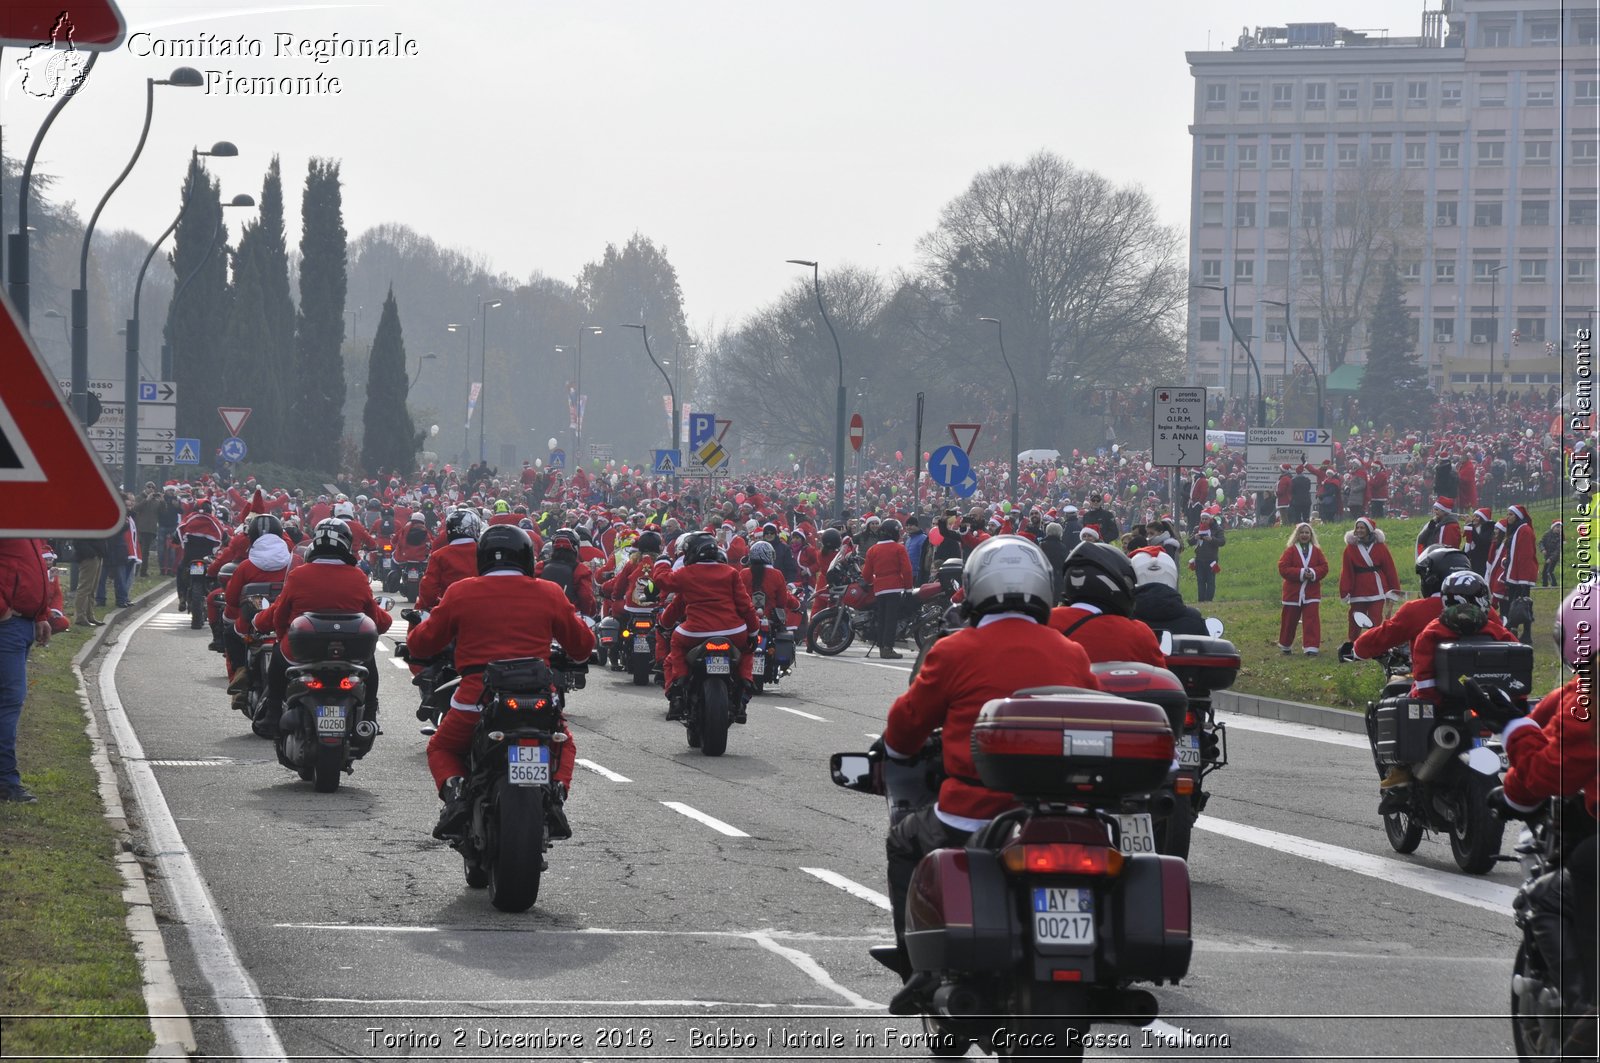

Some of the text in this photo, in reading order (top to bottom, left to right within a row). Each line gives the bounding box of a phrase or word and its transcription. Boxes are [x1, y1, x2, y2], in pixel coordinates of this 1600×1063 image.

[696, 417, 708, 436] P
[1249, 435, 1278, 443] Lingotto
[1276, 447, 1303, 455] Torino
[318, 719, 345, 730] 40260
[511, 765, 548, 781] 36623
[1122, 835, 1153, 852] 050
[1038, 917, 1091, 939] 00217
